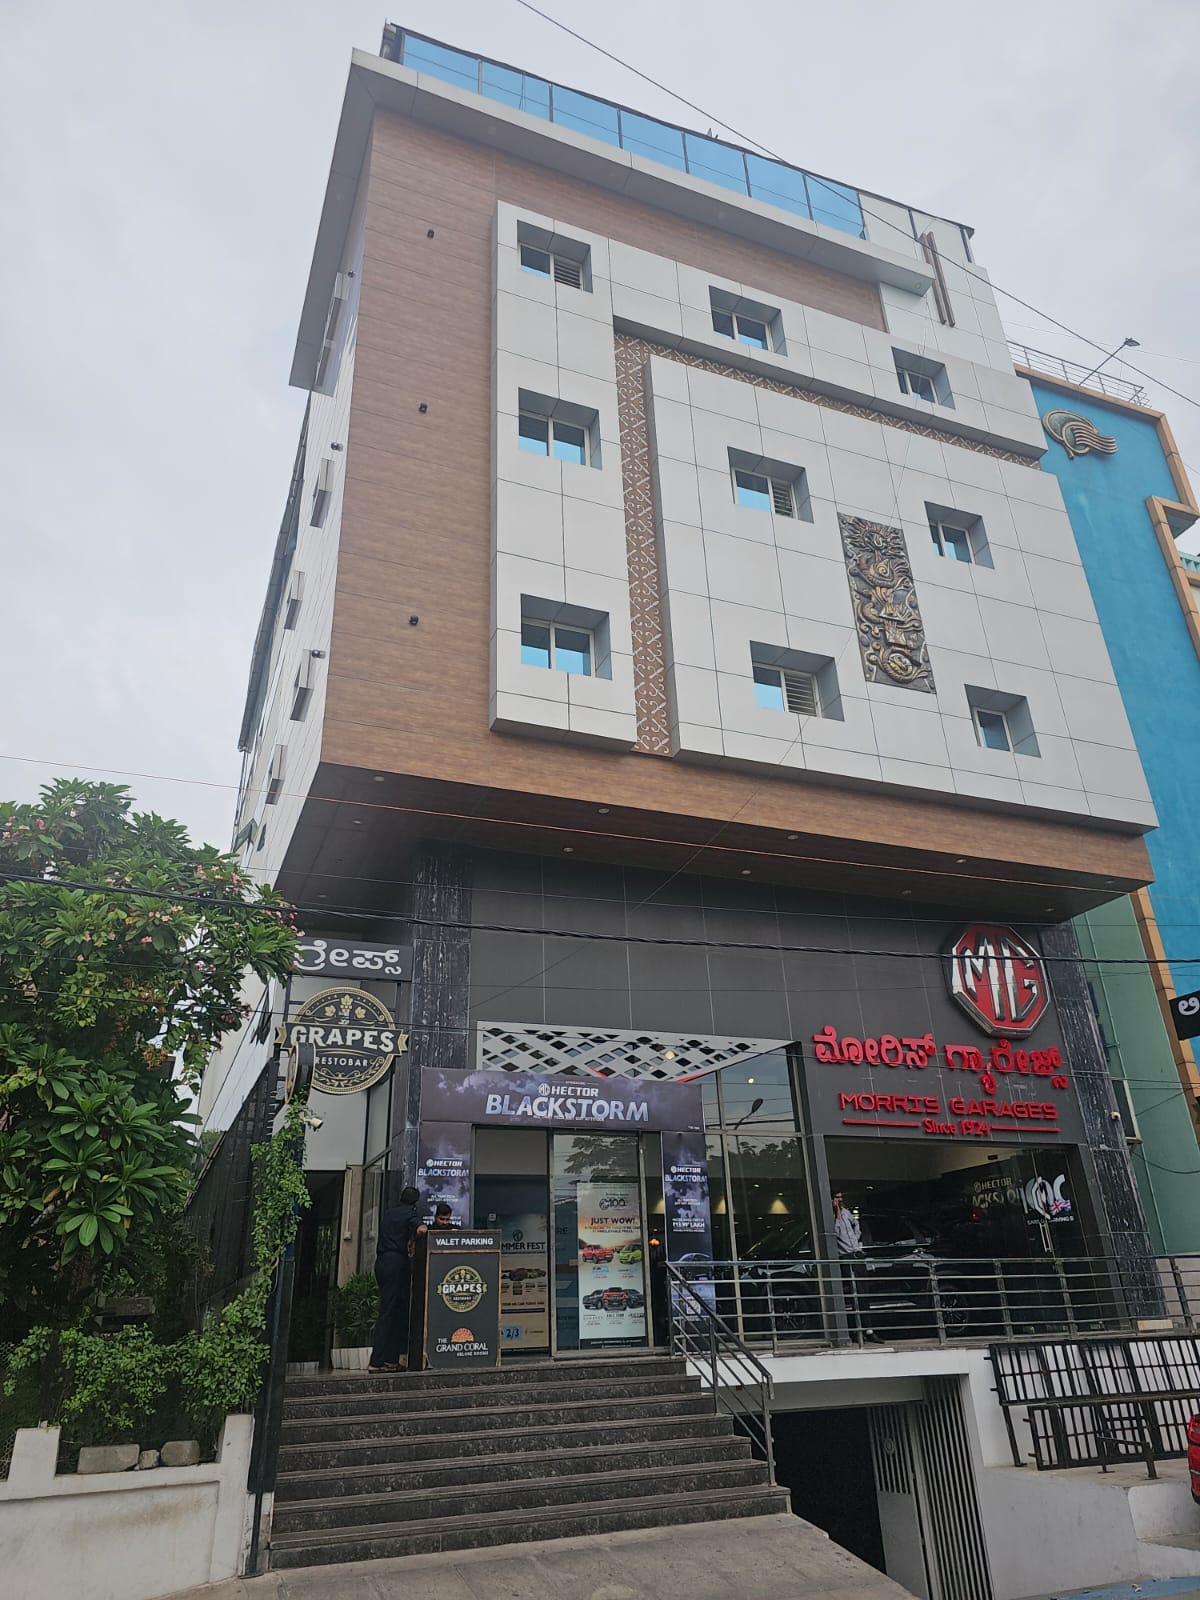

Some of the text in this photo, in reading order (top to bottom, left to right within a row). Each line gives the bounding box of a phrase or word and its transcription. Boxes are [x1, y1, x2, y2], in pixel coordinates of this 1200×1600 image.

[290, 1025, 395, 1053] GRAPES
[315, 1056, 368, 1067] RESTOBAR
[551, 1085, 599, 1097] HECTOR
[485, 1094, 649, 1122] BLACKSTORM
[839, 1092, 1059, 1120] MORRIS GARAGES
[923, 1117, 991, 1136] Since 1924
[418, 1168, 470, 1177] BLACKSTORM
[664, 1174, 708, 1183] BLACKSTORM
[981, 1177, 1013, 1190] HECTOR
[590, 1217, 636, 1226] JUST WOW!
[436, 1238, 494, 1246] VALET PARKING
[526, 1242, 546, 1250] FEST
[442, 1283, 482, 1294] GRAPES
[436, 1342, 489, 1353] GRAND CORAL
